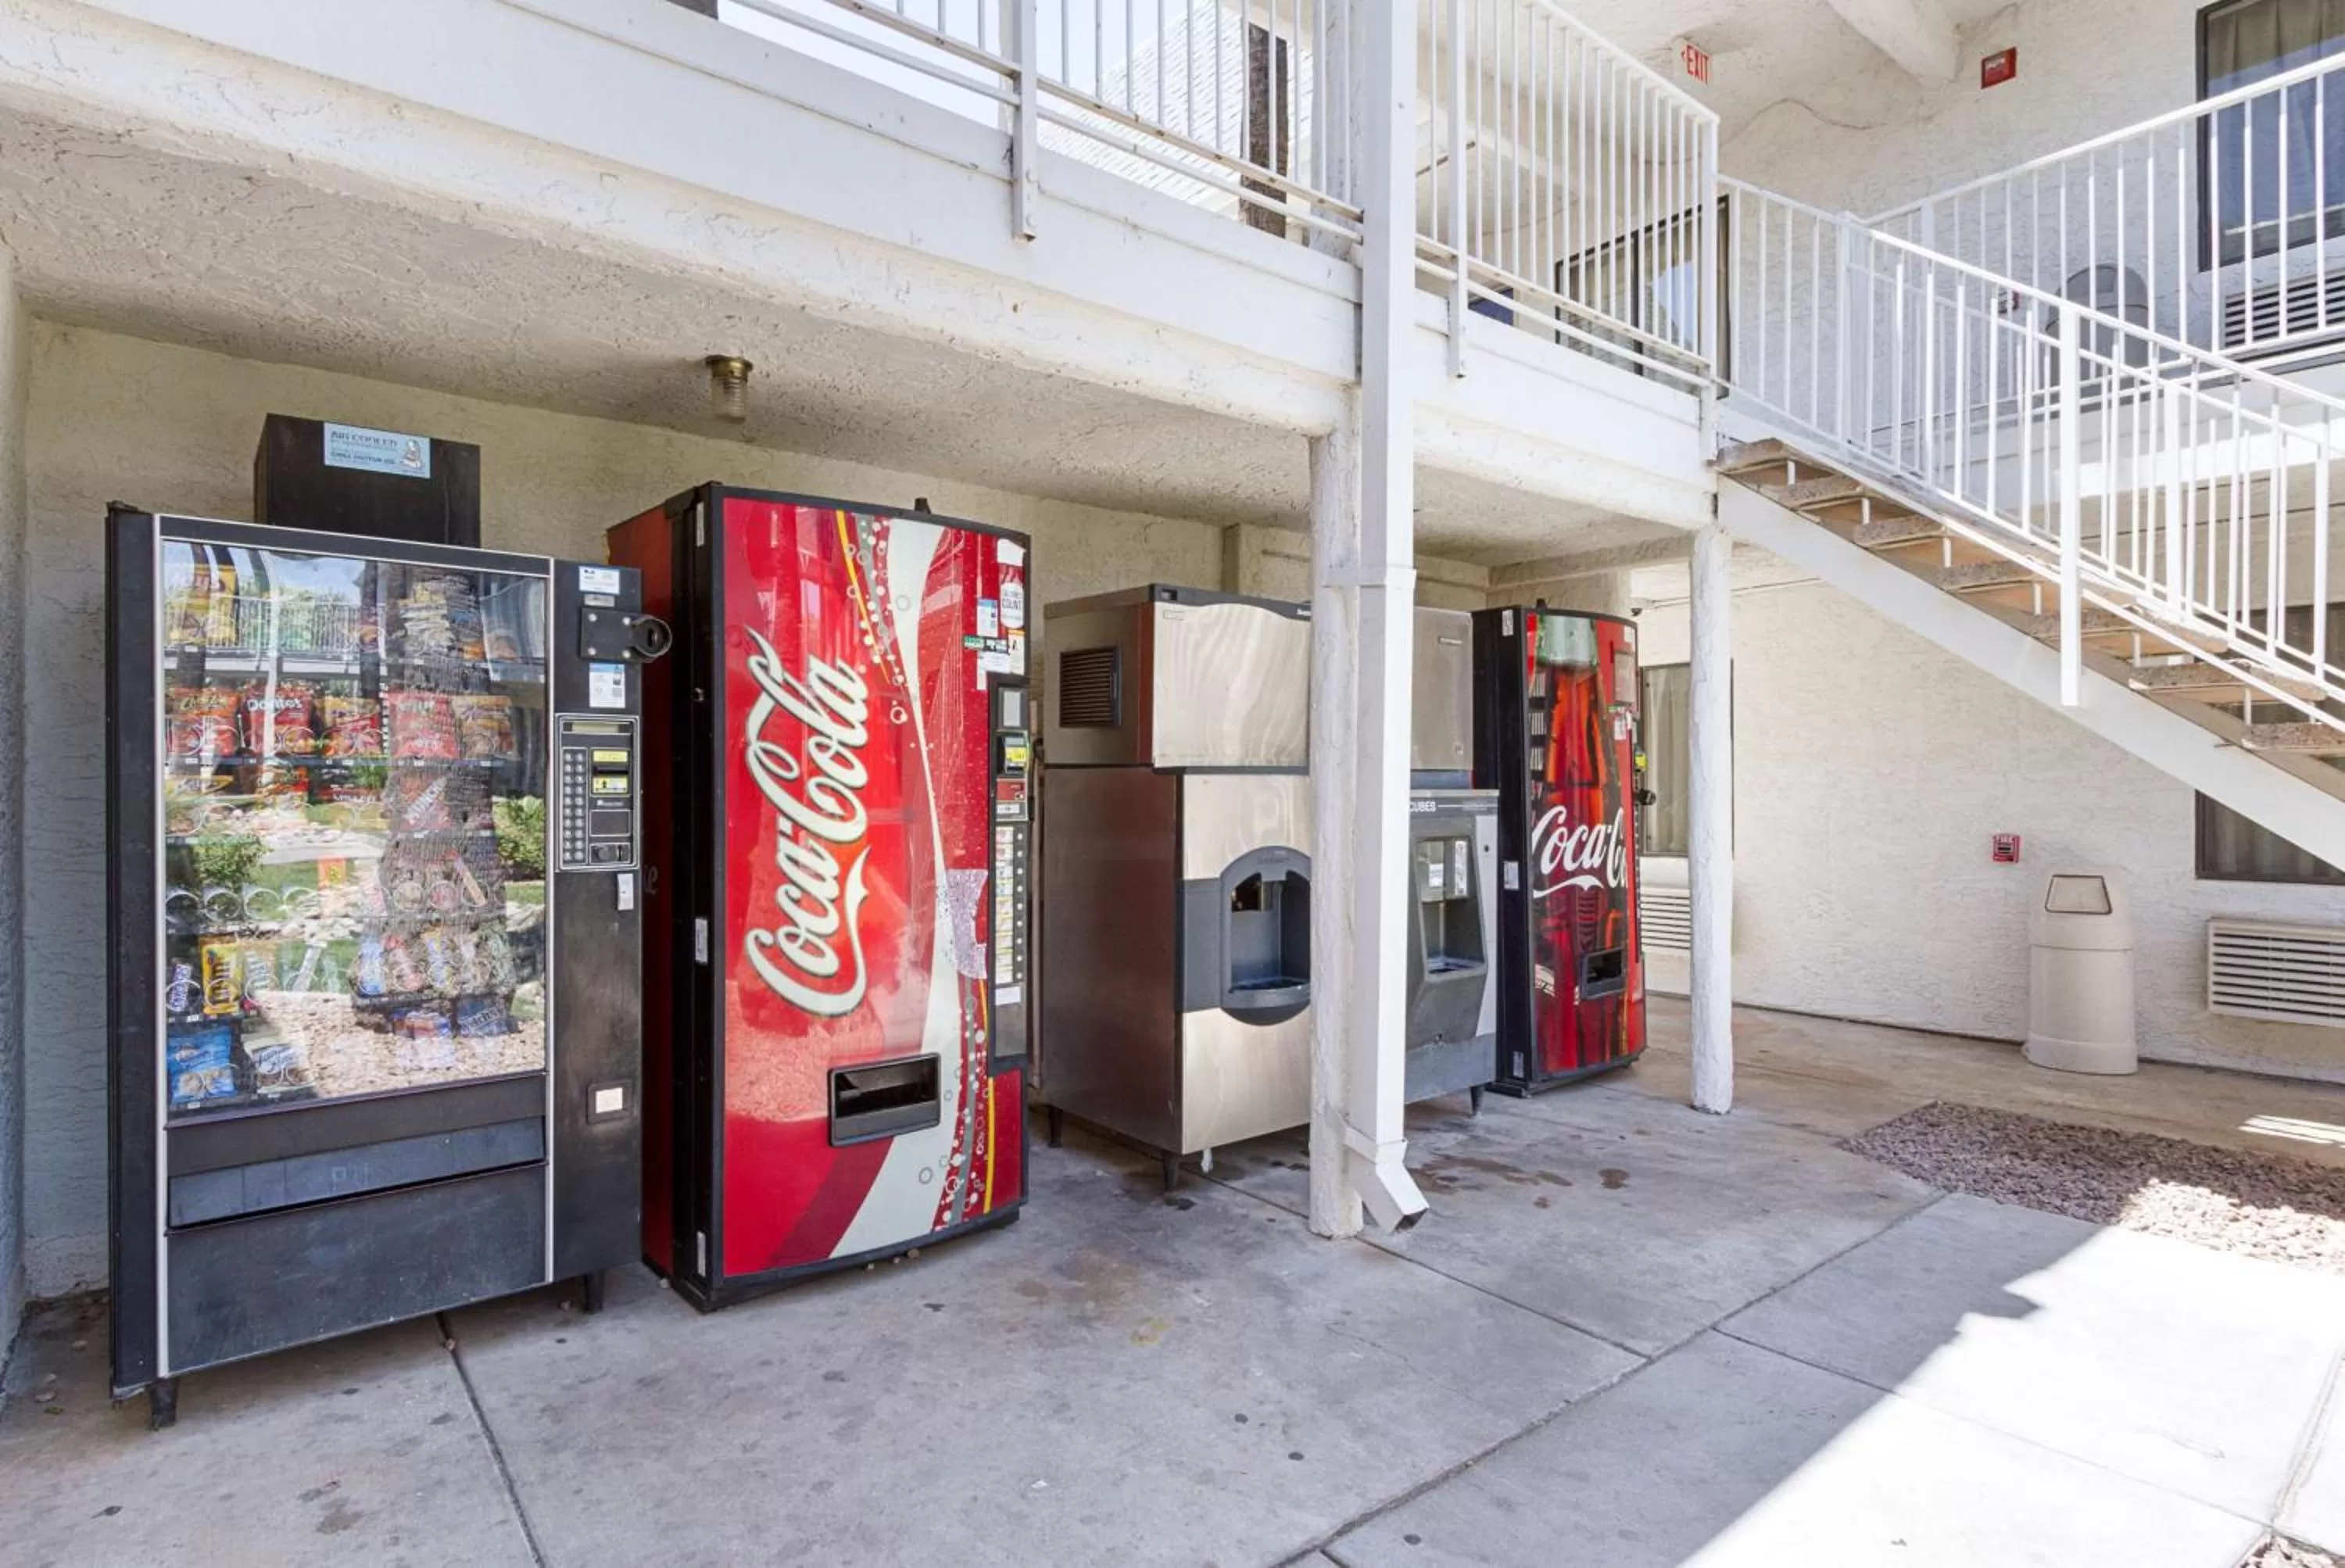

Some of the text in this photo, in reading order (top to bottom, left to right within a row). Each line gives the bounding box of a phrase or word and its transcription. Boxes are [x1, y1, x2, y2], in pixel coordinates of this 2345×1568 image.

[1686, 44, 1710, 85] EXIT
[247, 695, 303, 711] Doitos
[745, 625, 870, 1016] Coca-Cola
